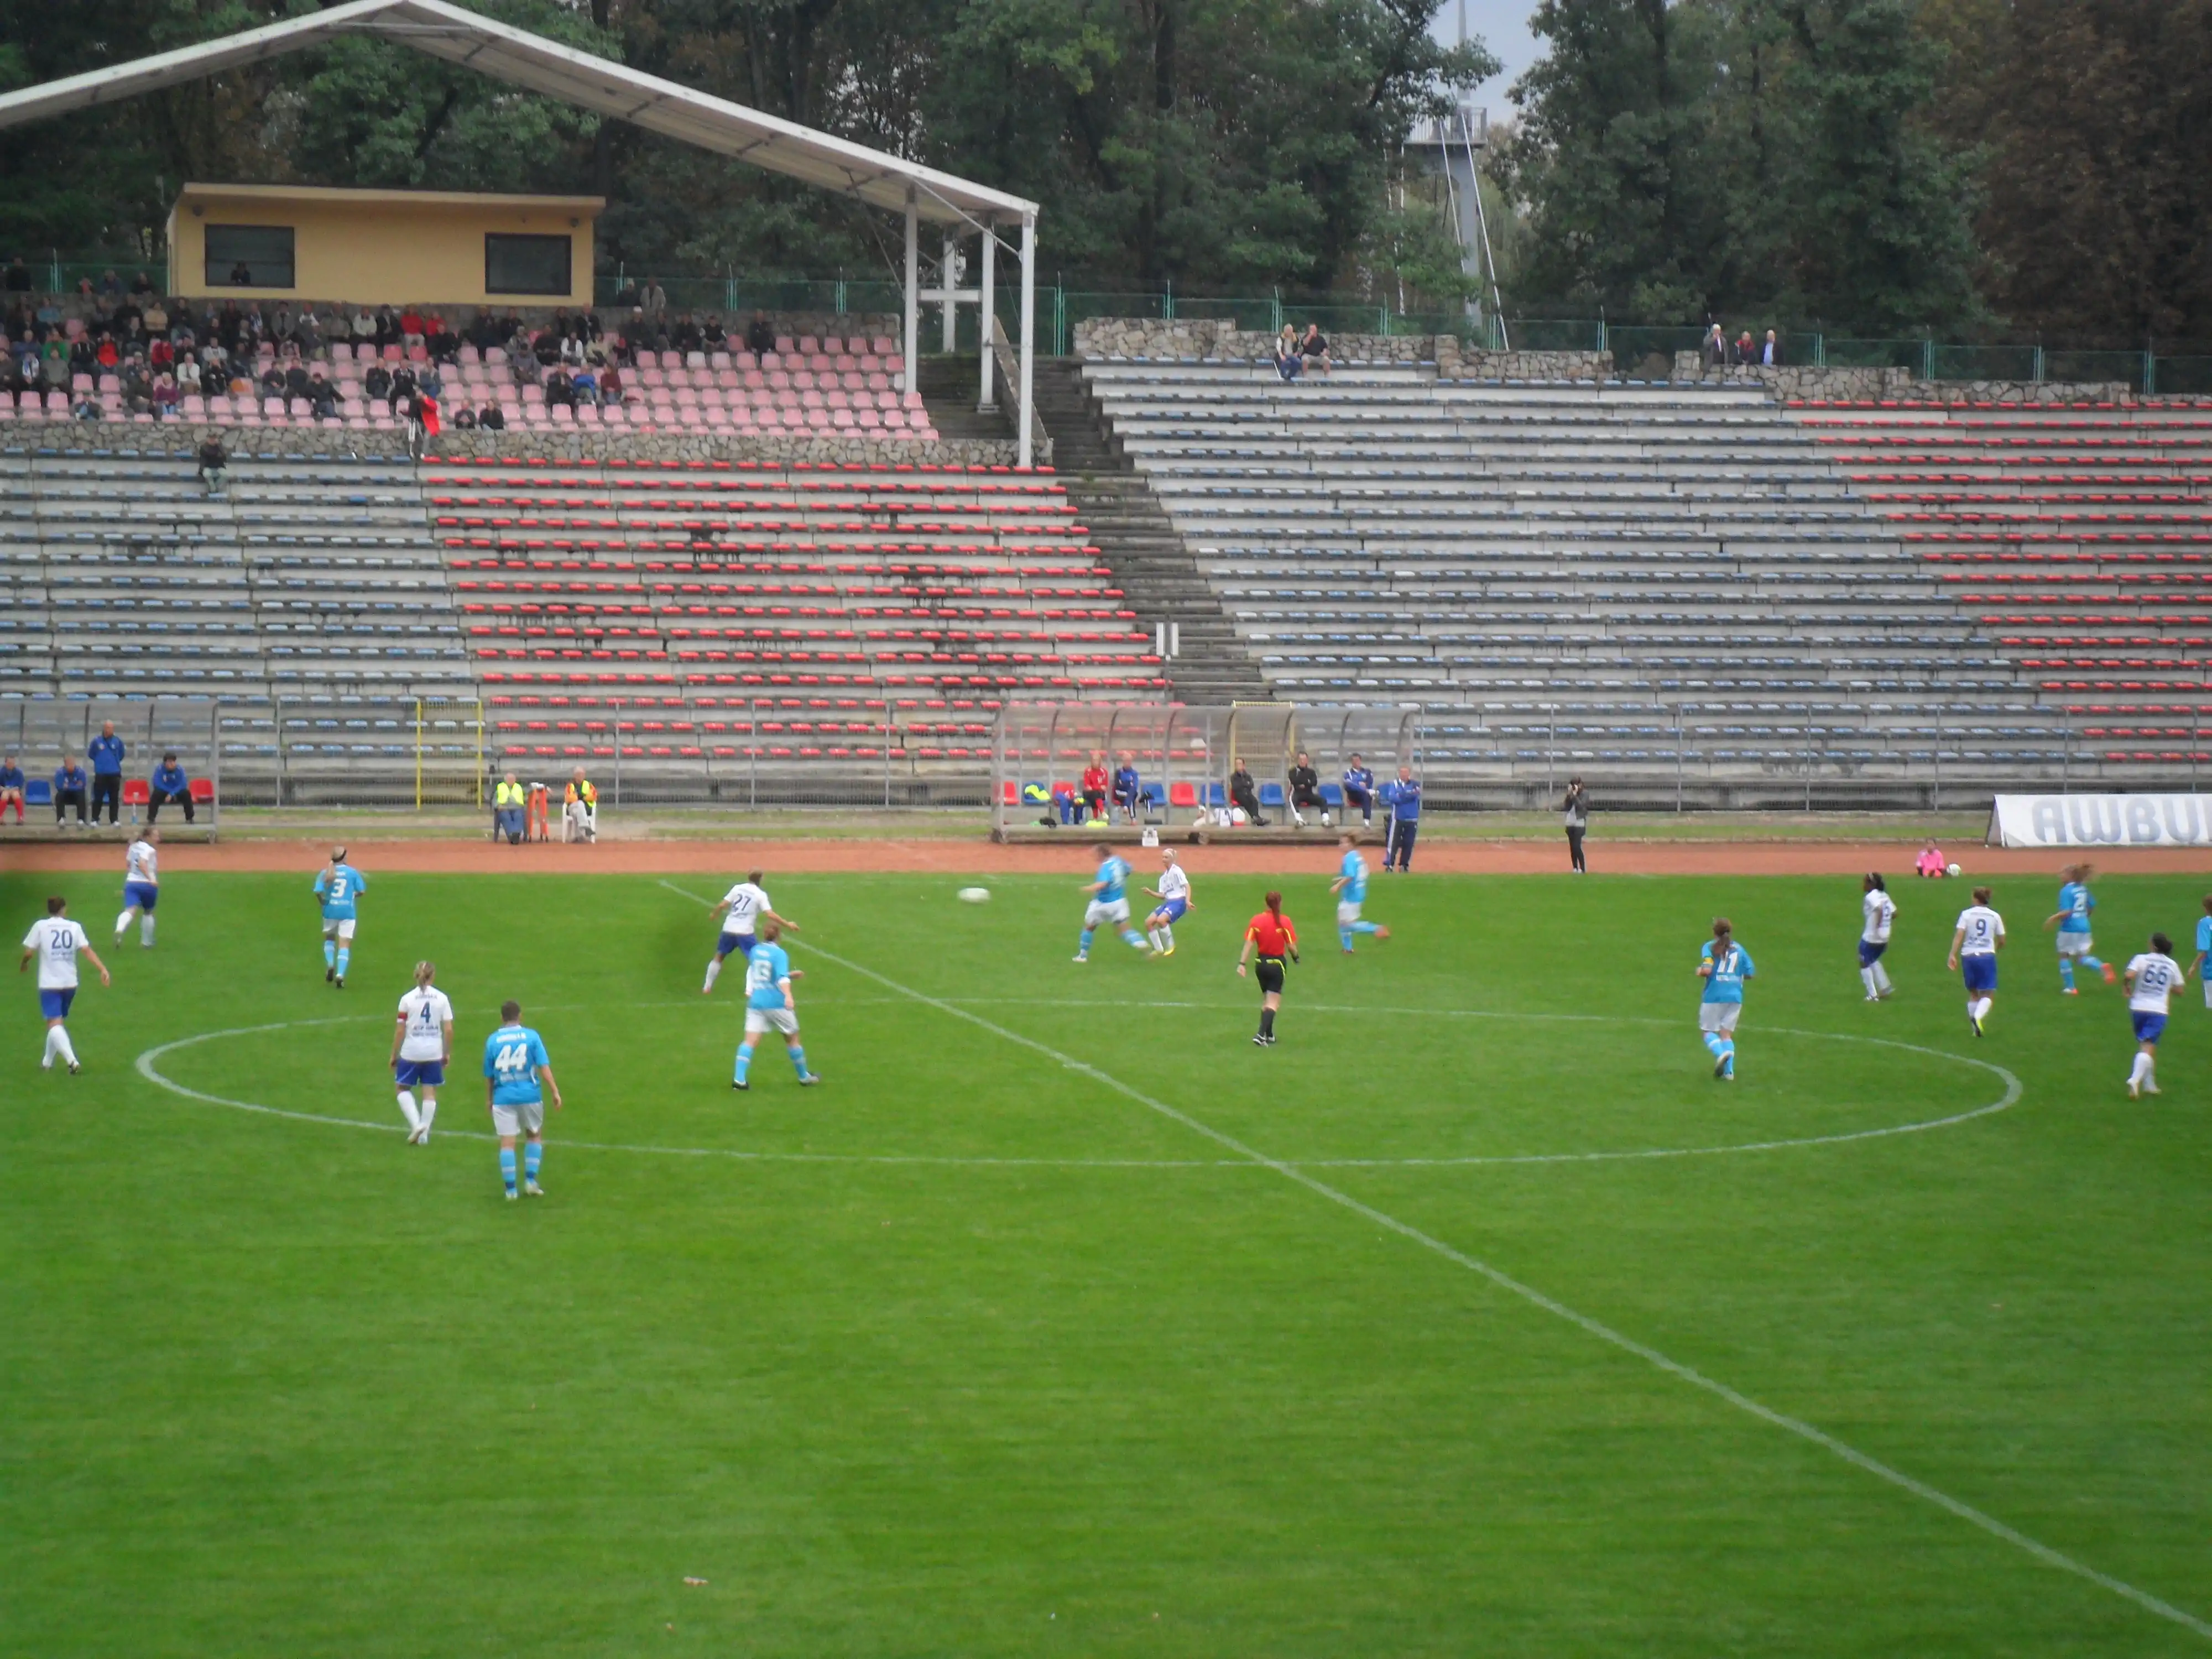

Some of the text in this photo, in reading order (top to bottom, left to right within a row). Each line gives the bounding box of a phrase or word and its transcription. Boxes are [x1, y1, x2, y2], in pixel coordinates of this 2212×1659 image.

[2032, 797, 2212, 843] AWBU
[331, 878, 347, 898] 3
[732, 894, 751, 912] 27
[1976, 919, 1986, 937] 9
[51, 930, 73, 950] 20
[1717, 951, 1738, 973] 11
[420, 1001, 431, 1024] 4
[495, 1043, 526, 1073] 44
